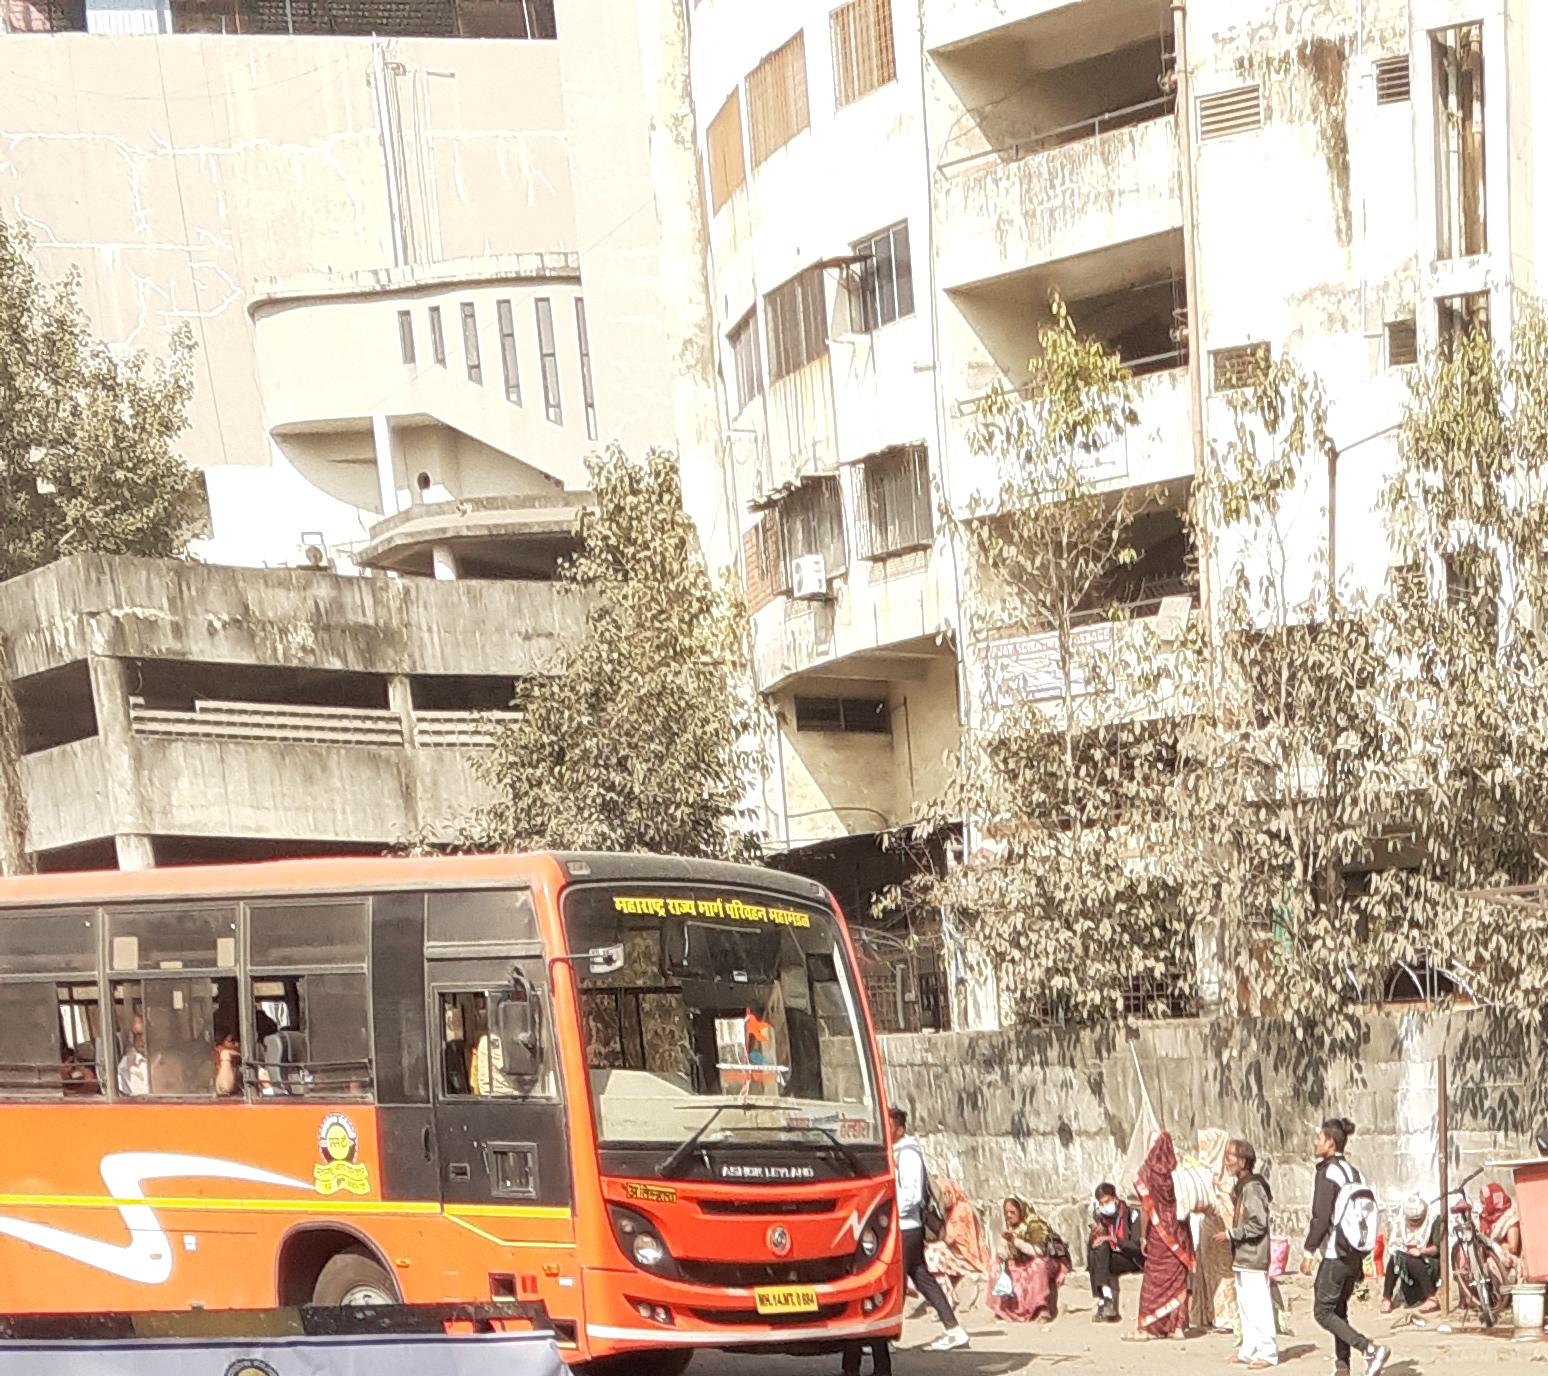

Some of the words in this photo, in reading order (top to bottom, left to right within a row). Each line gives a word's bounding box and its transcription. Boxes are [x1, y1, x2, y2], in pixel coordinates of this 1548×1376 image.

[666, 898, 697, 916] राज्य
[697, 898, 724, 918] मार्ग
[724, 899, 769, 923] परिवहन
